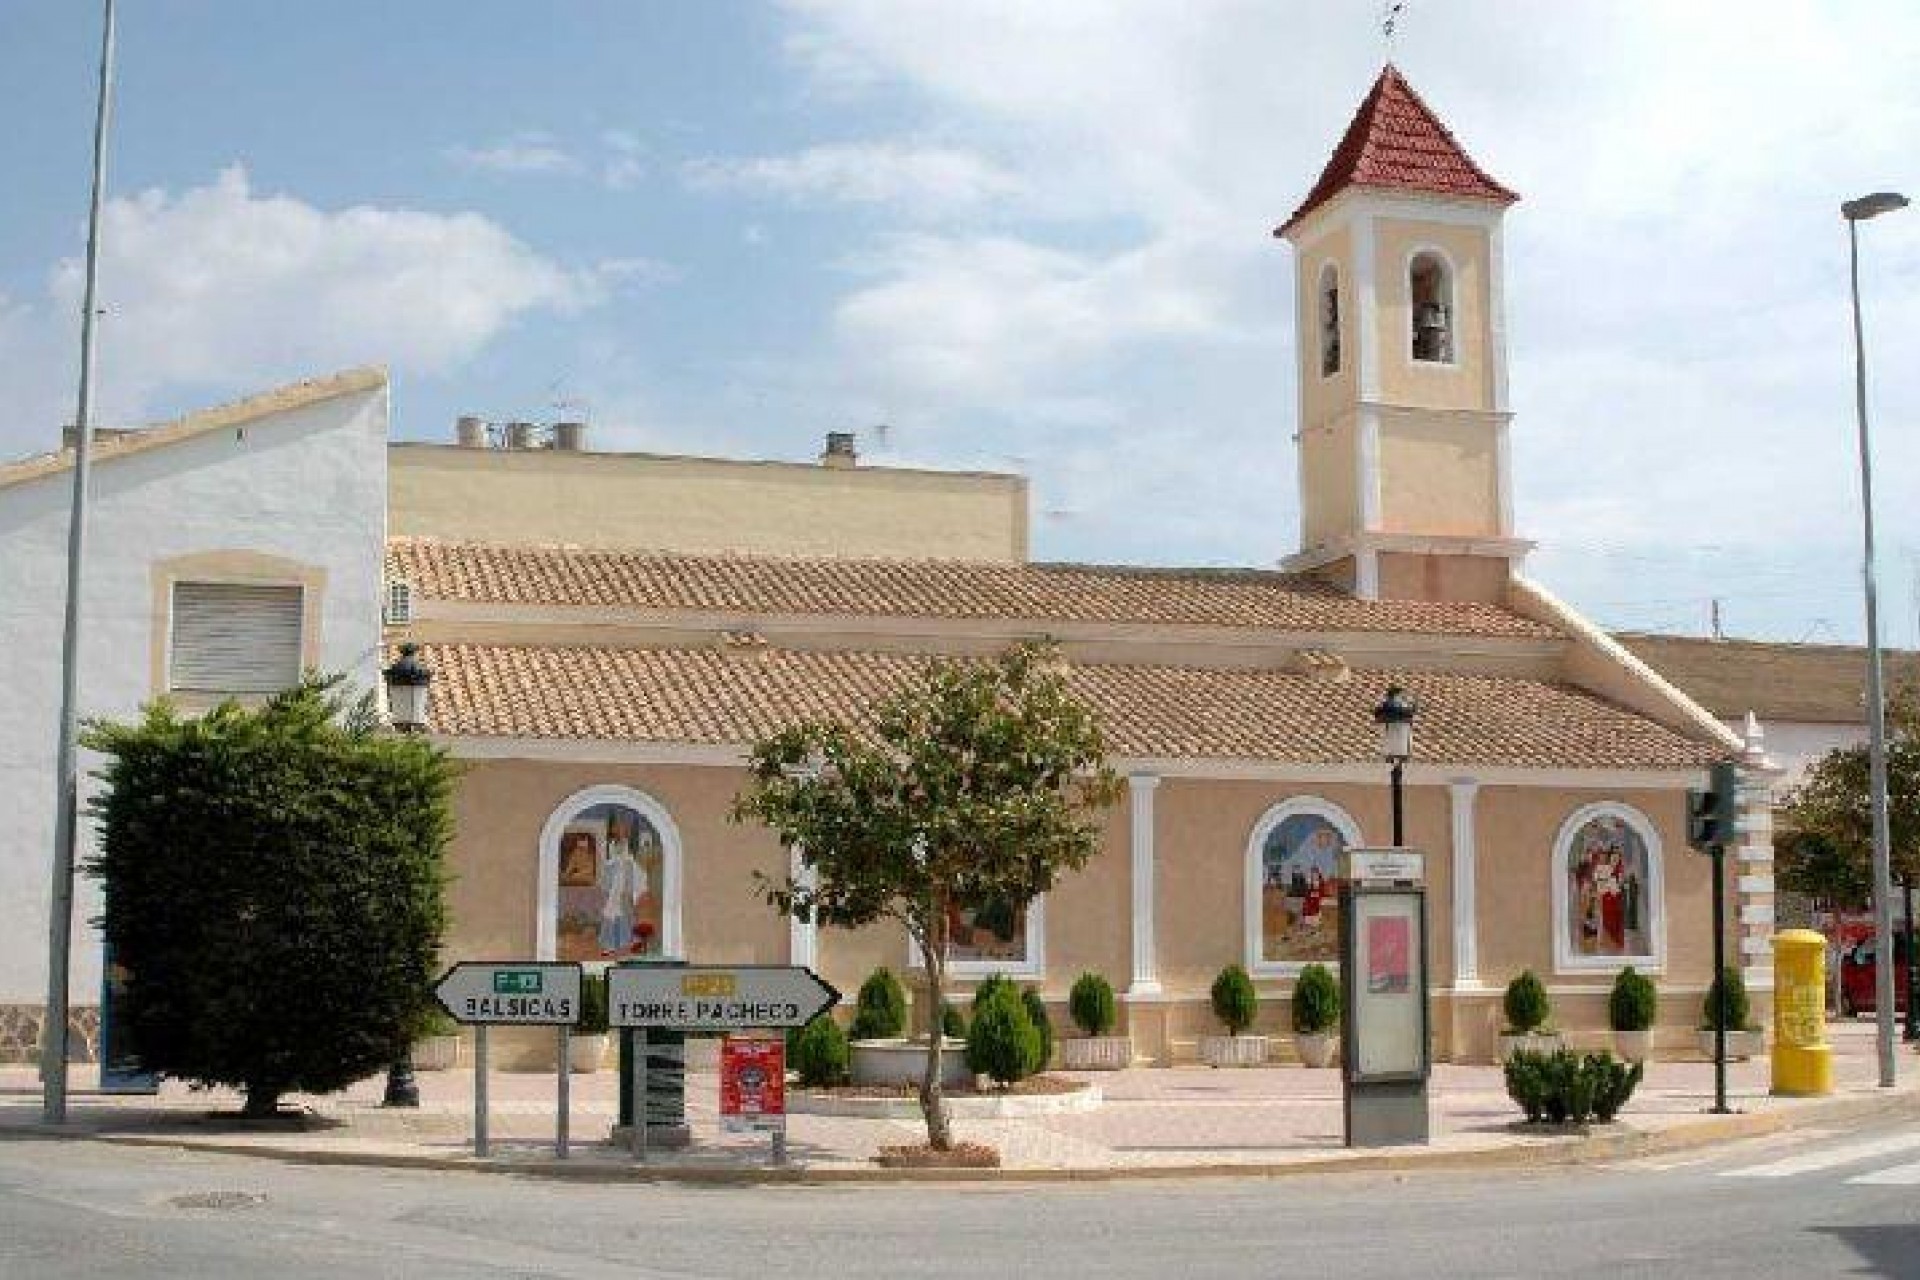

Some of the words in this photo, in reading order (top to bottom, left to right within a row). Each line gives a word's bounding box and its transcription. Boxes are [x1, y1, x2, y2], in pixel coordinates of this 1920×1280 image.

[465, 998, 570, 1017] BALSICAS
[618, 1002, 687, 1019] TORRE
[697, 1002, 799, 1019] PACHECO
